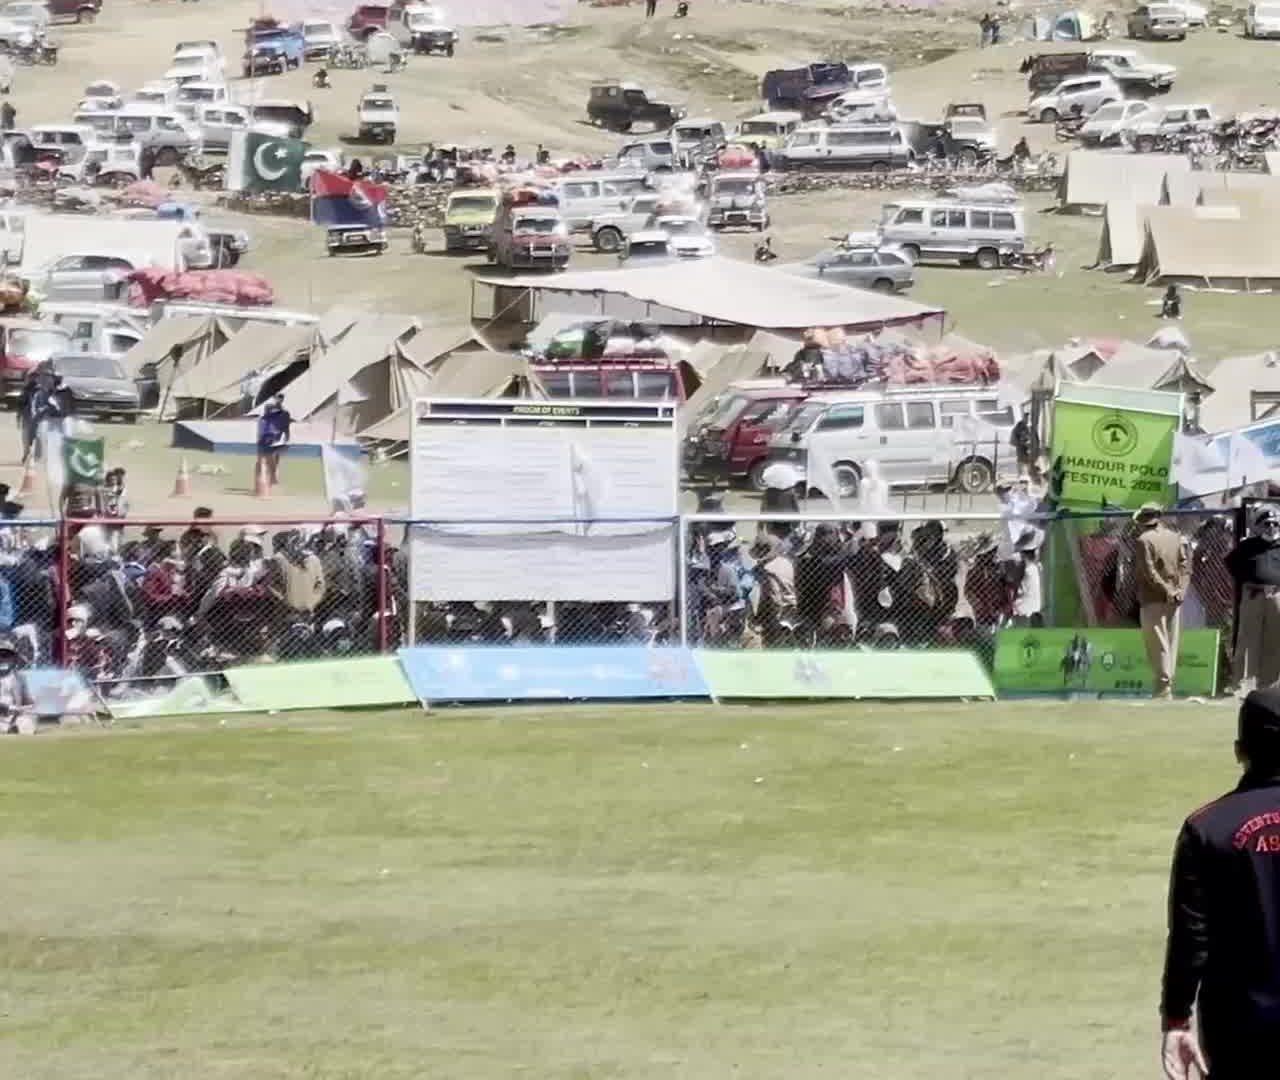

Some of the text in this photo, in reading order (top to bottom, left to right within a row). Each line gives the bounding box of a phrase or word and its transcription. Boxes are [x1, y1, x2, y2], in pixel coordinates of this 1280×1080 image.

[1064, 456, 1169, 478] HANDUR POLO
[1063, 471, 1126, 489] FESTIVAL
